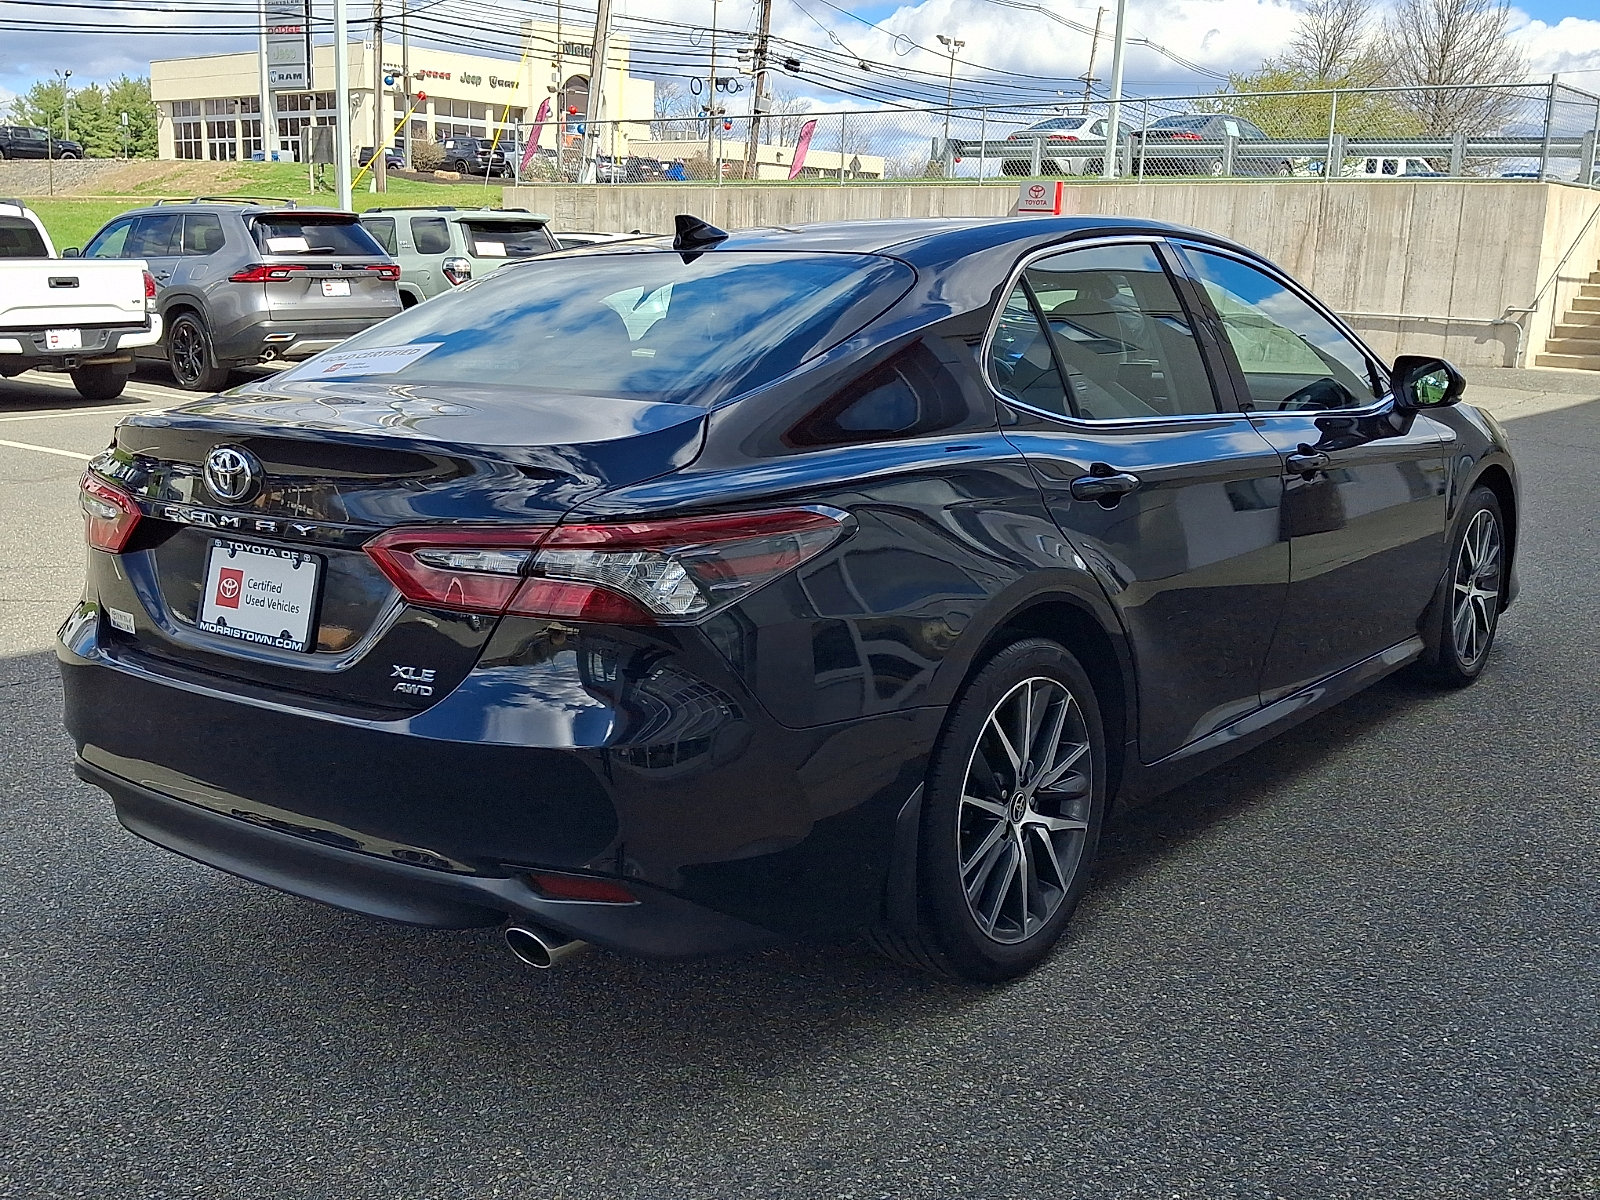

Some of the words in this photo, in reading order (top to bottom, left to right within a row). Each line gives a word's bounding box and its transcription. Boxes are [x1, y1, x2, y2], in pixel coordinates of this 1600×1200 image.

[273, 46, 297, 61] Jeep
[278, 73, 302, 81] RAM
[460, 72, 482, 87] Jeep
[227, 541, 278, 556] TOYOTA
[281, 550, 299, 559] OF
[247, 578, 283, 594] Certified
[245, 594, 266, 608] Used
[267, 597, 300, 614] Vehicles
[199, 622, 303, 652] MORRISTOWN.COM
[390, 664, 436, 682] XLE
[392, 682, 433, 696] AWD
